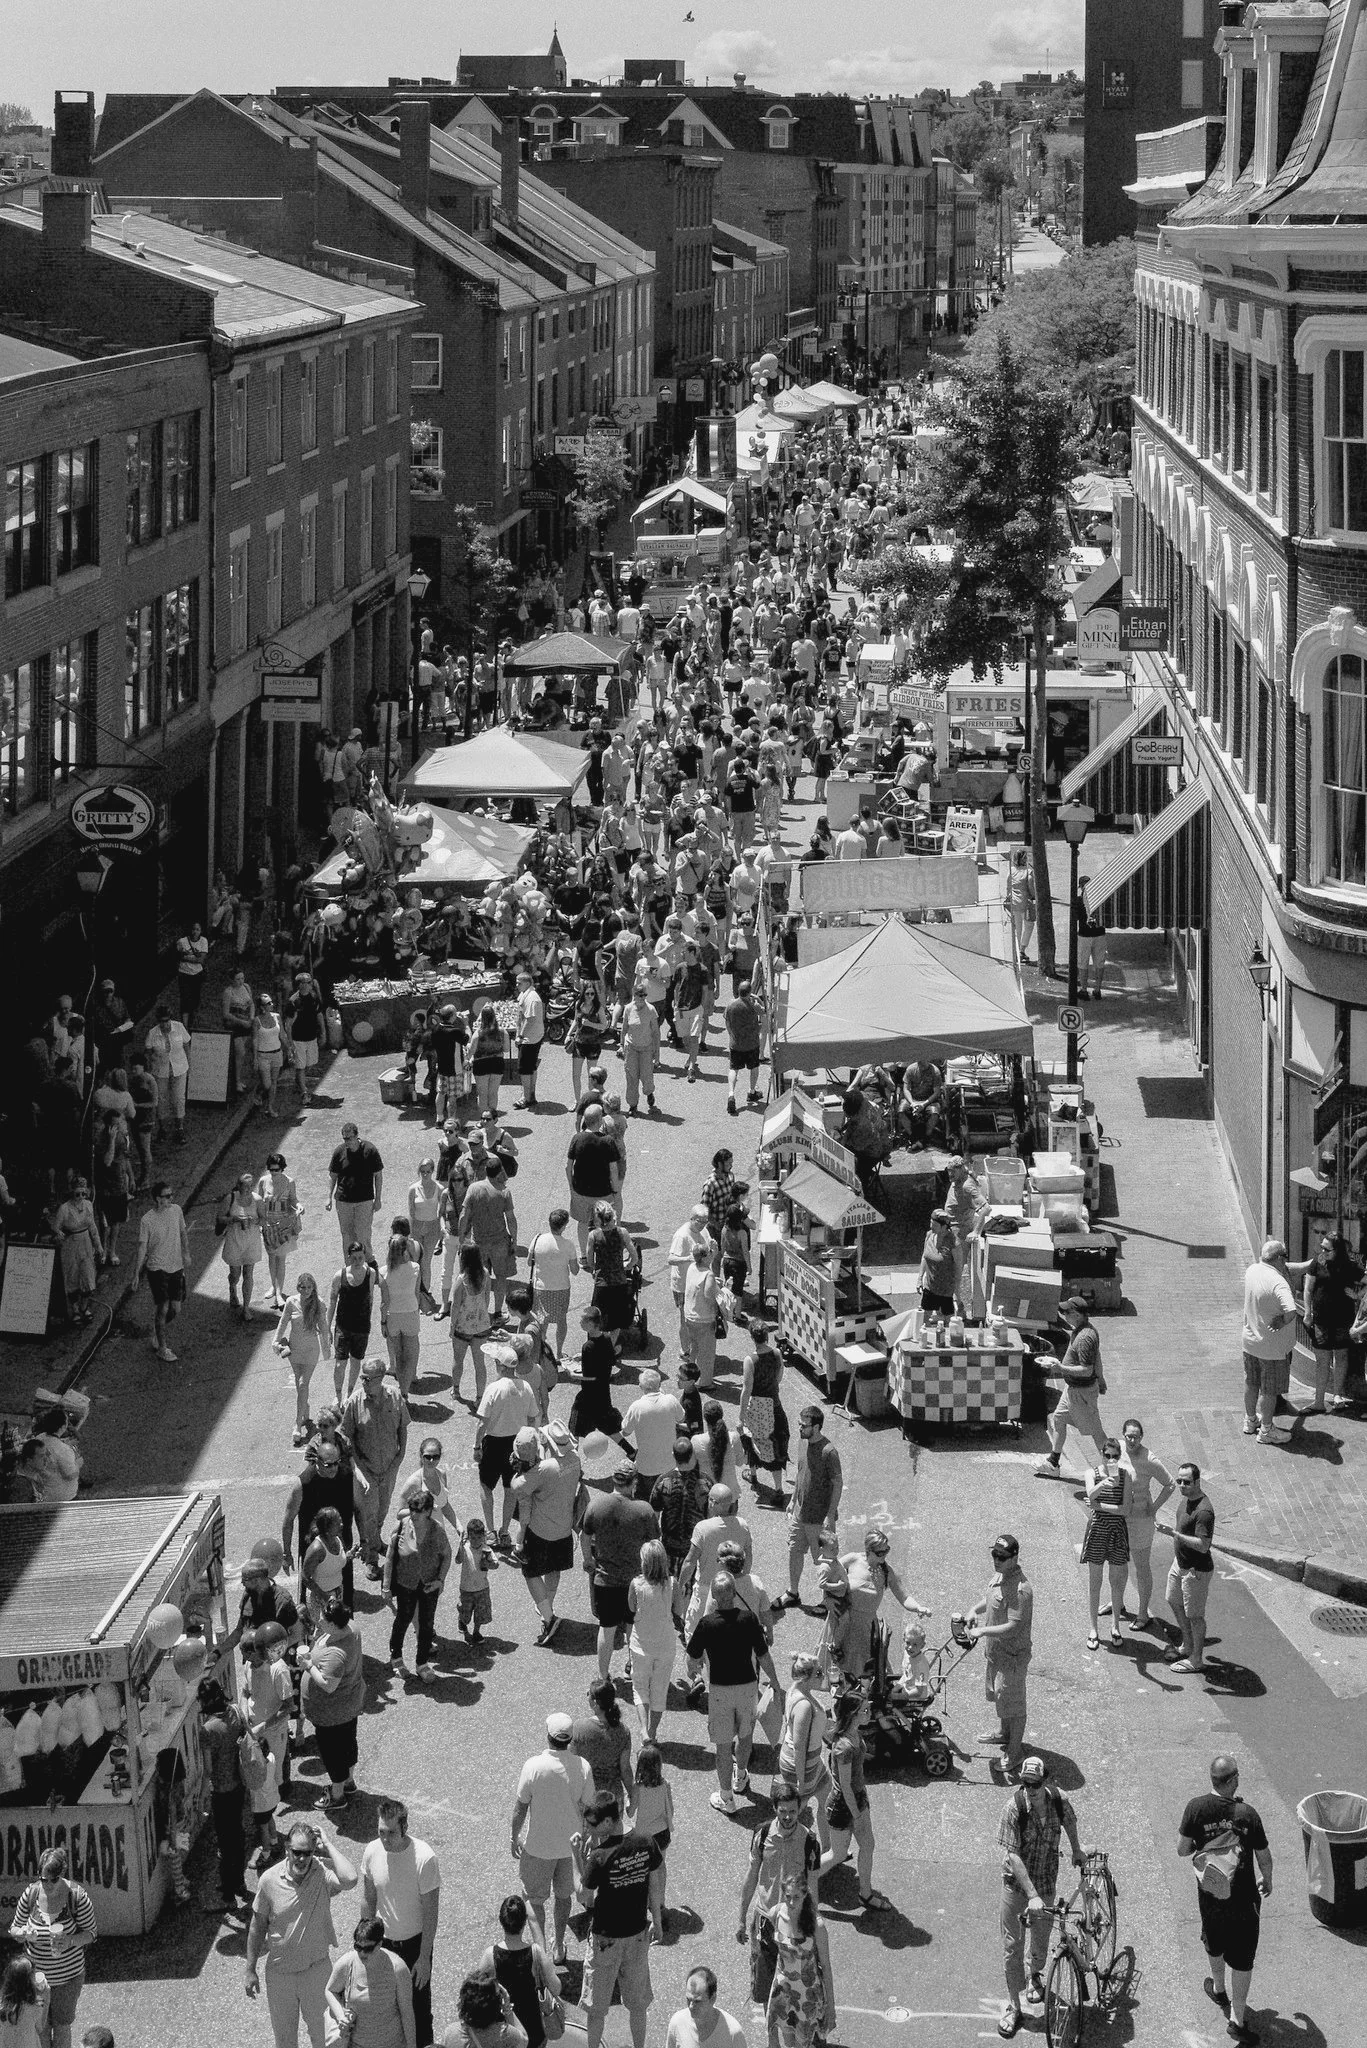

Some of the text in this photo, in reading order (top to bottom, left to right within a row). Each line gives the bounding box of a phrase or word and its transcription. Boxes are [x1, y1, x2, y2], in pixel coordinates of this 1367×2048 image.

[1131, 617, 1166, 630] Ethan
[1122, 625, 1163, 638] Hunter
[900, 688, 918, 696] SWEET
[893, 693, 920, 706] RIBBON
[923, 698, 945, 710] FRIES
[956, 697, 1022, 712] FRIES
[74, 810, 147, 823] GRITTY'S
[949, 821, 977, 830] AREPA
[847, 1202, 871, 1213] ITALIAN
[841, 1212, 877, 1227] SAUSAGE
[785, 1263, 818, 1302] HOT DOGS
[17, 1653, 112, 1685] ORANGEADE
[0, 1823, 129, 1893] RANGEADE
